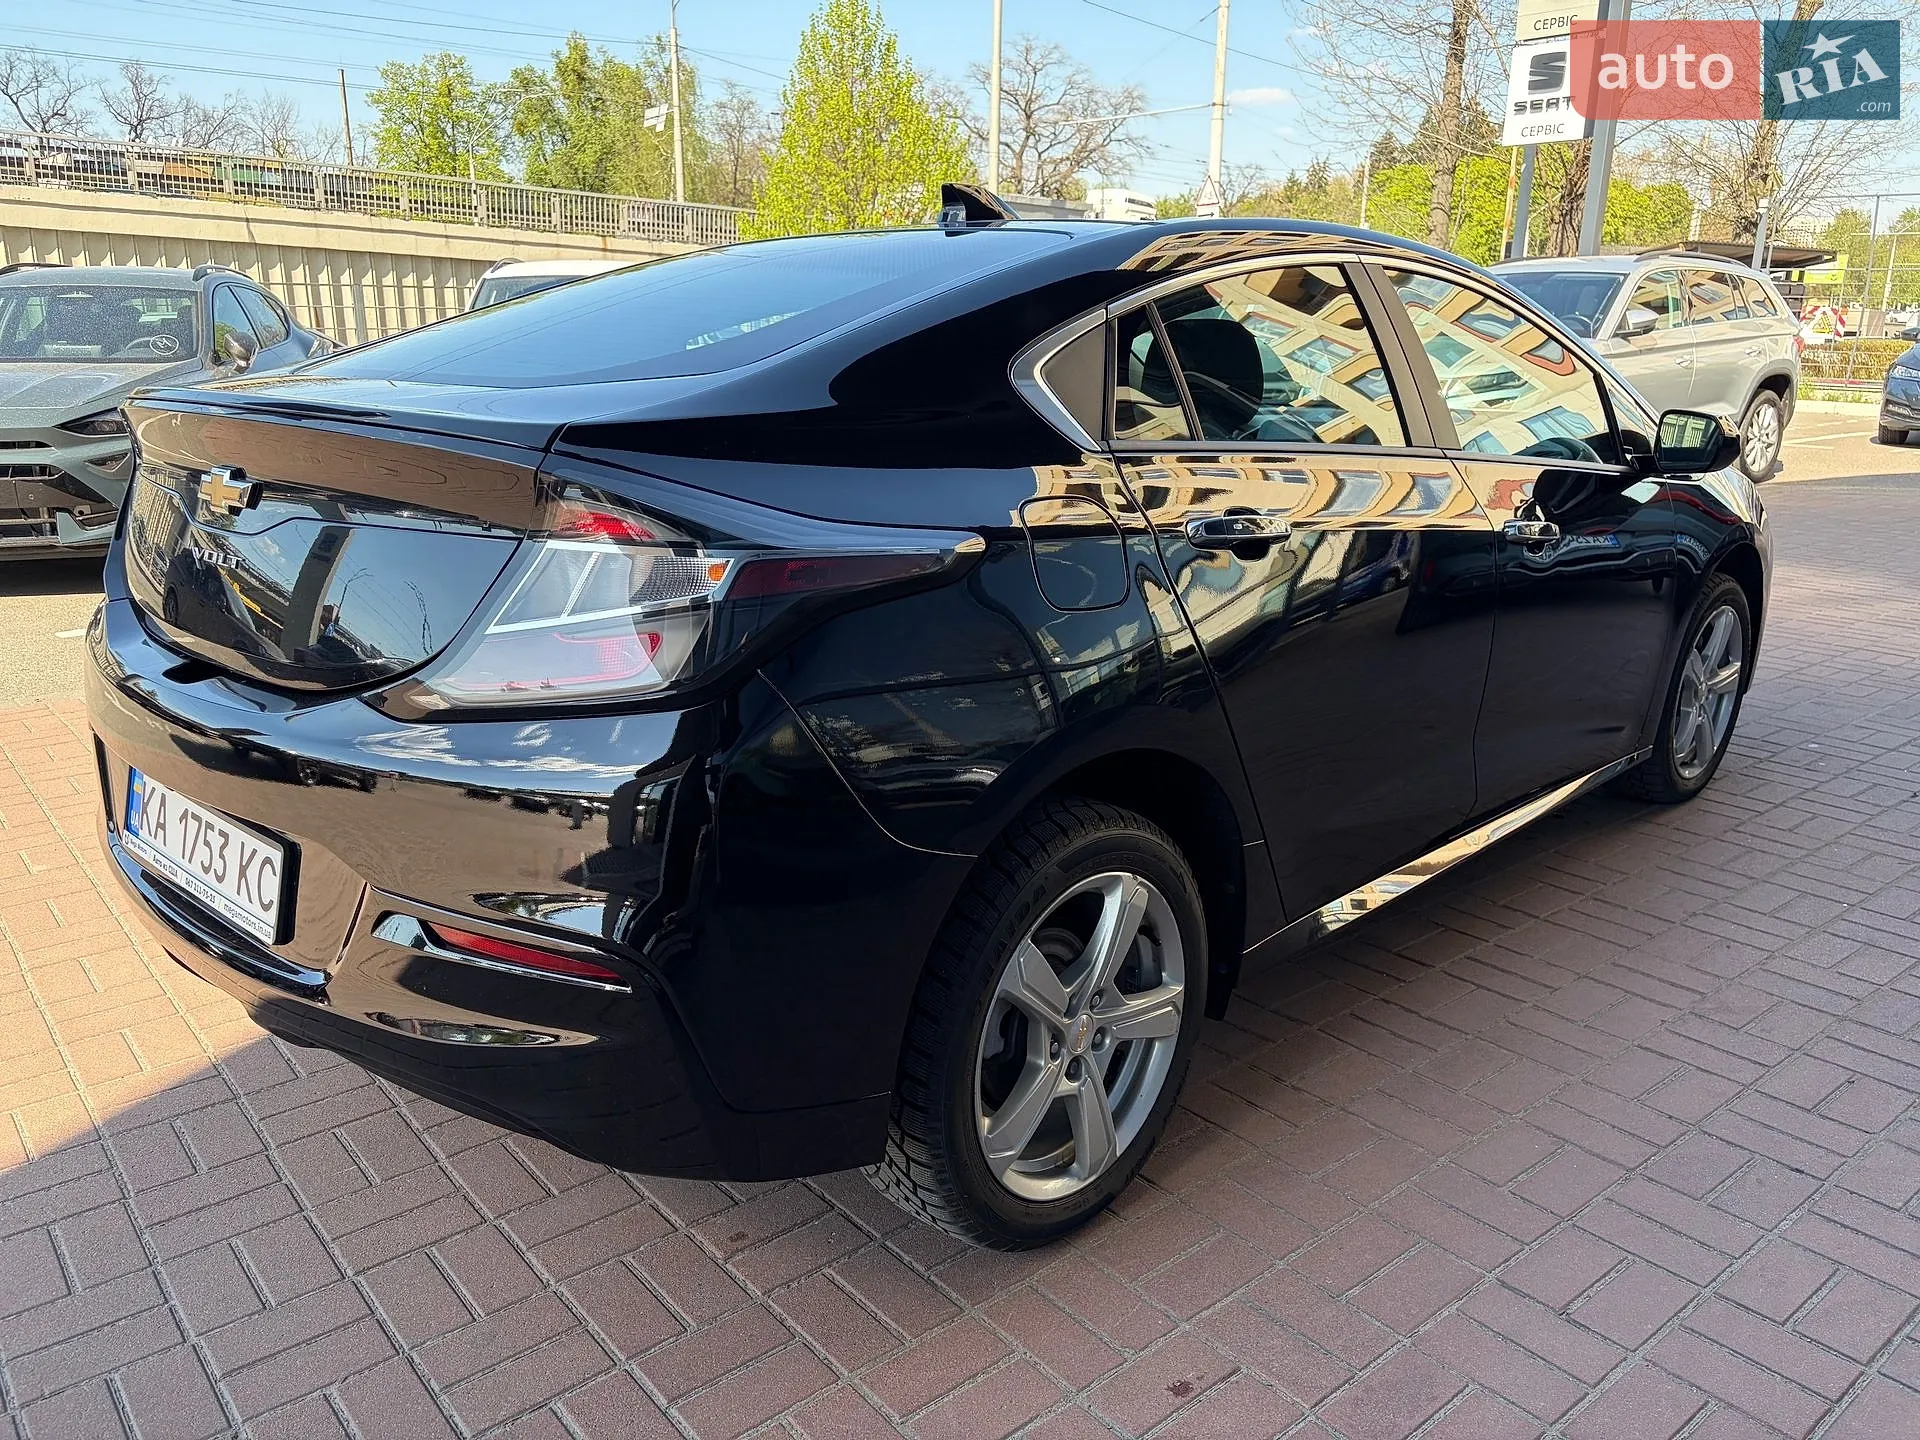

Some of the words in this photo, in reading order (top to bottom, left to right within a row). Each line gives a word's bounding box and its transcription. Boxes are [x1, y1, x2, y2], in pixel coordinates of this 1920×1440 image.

[1534, 14, 1579, 31] СЕРВІС
[1513, 96, 1576, 116] SEAT
[1521, 123, 1565, 138] СЕРВІС
[191, 546, 242, 569] VOLT
[131, 811, 140, 828] UA
[140, 781, 167, 847] KA
[178, 807, 230, 884] 1753
[236, 840, 277, 913] KC
